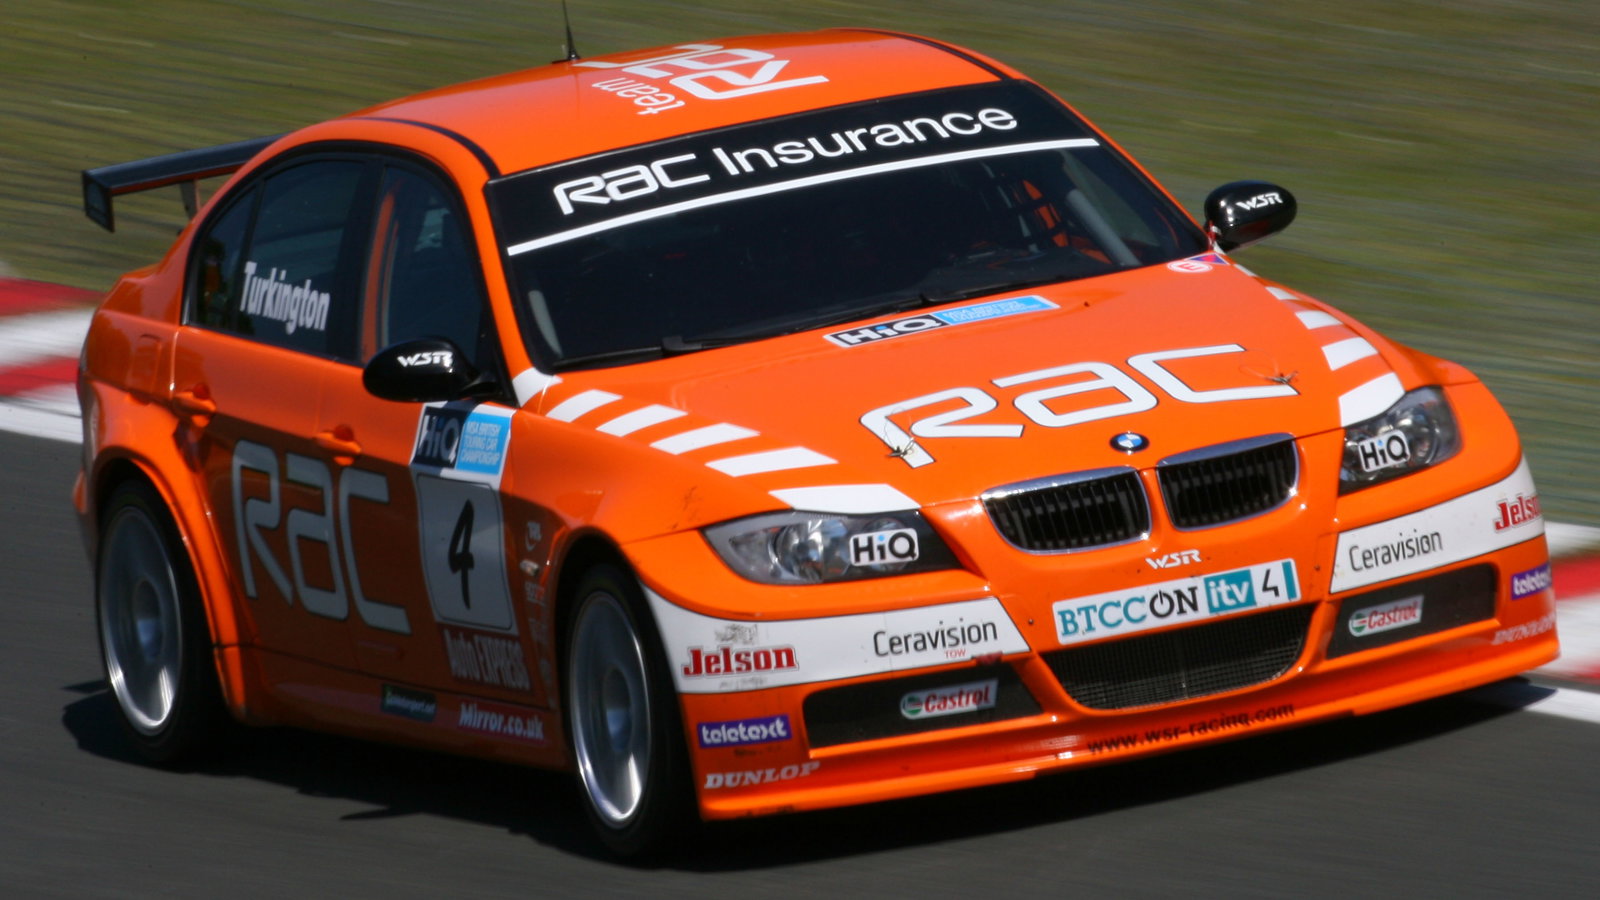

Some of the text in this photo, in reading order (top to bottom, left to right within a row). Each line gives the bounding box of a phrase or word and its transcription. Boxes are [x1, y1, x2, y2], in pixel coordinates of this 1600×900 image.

[591, 77, 686, 115] team
[713, 108, 1018, 175] Insurance
[1235, 192, 1284, 211] WSR
[239, 261, 331, 336] Turkington
[835, 315, 945, 344] HiQ
[397, 351, 454, 369] WSR
[417, 415, 460, 463] HiQ
[1359, 435, 1409, 470] HiQ
[448, 499, 475, 611] 4
[852, 531, 918, 564] HiQ
[1145, 549, 1202, 570] WSR
[1348, 528, 1444, 573] Ceravision
[1207, 578, 1250, 609] itv
[1261, 568, 1280, 598] 4
[1366, 603, 1420, 630] Castrol
[872, 617, 998, 658] Ceravision
[944, 648, 967, 659] TOW
[683, 646, 797, 676] Jelson
[922, 684, 992, 713] Castrol
[459, 702, 545, 740] Mirror.co.uk
[701, 716, 787, 745] teletext
[1087, 703, 1296, 754] www.wsr-racing.com
[703, 761, 820, 789] DUNLOP
